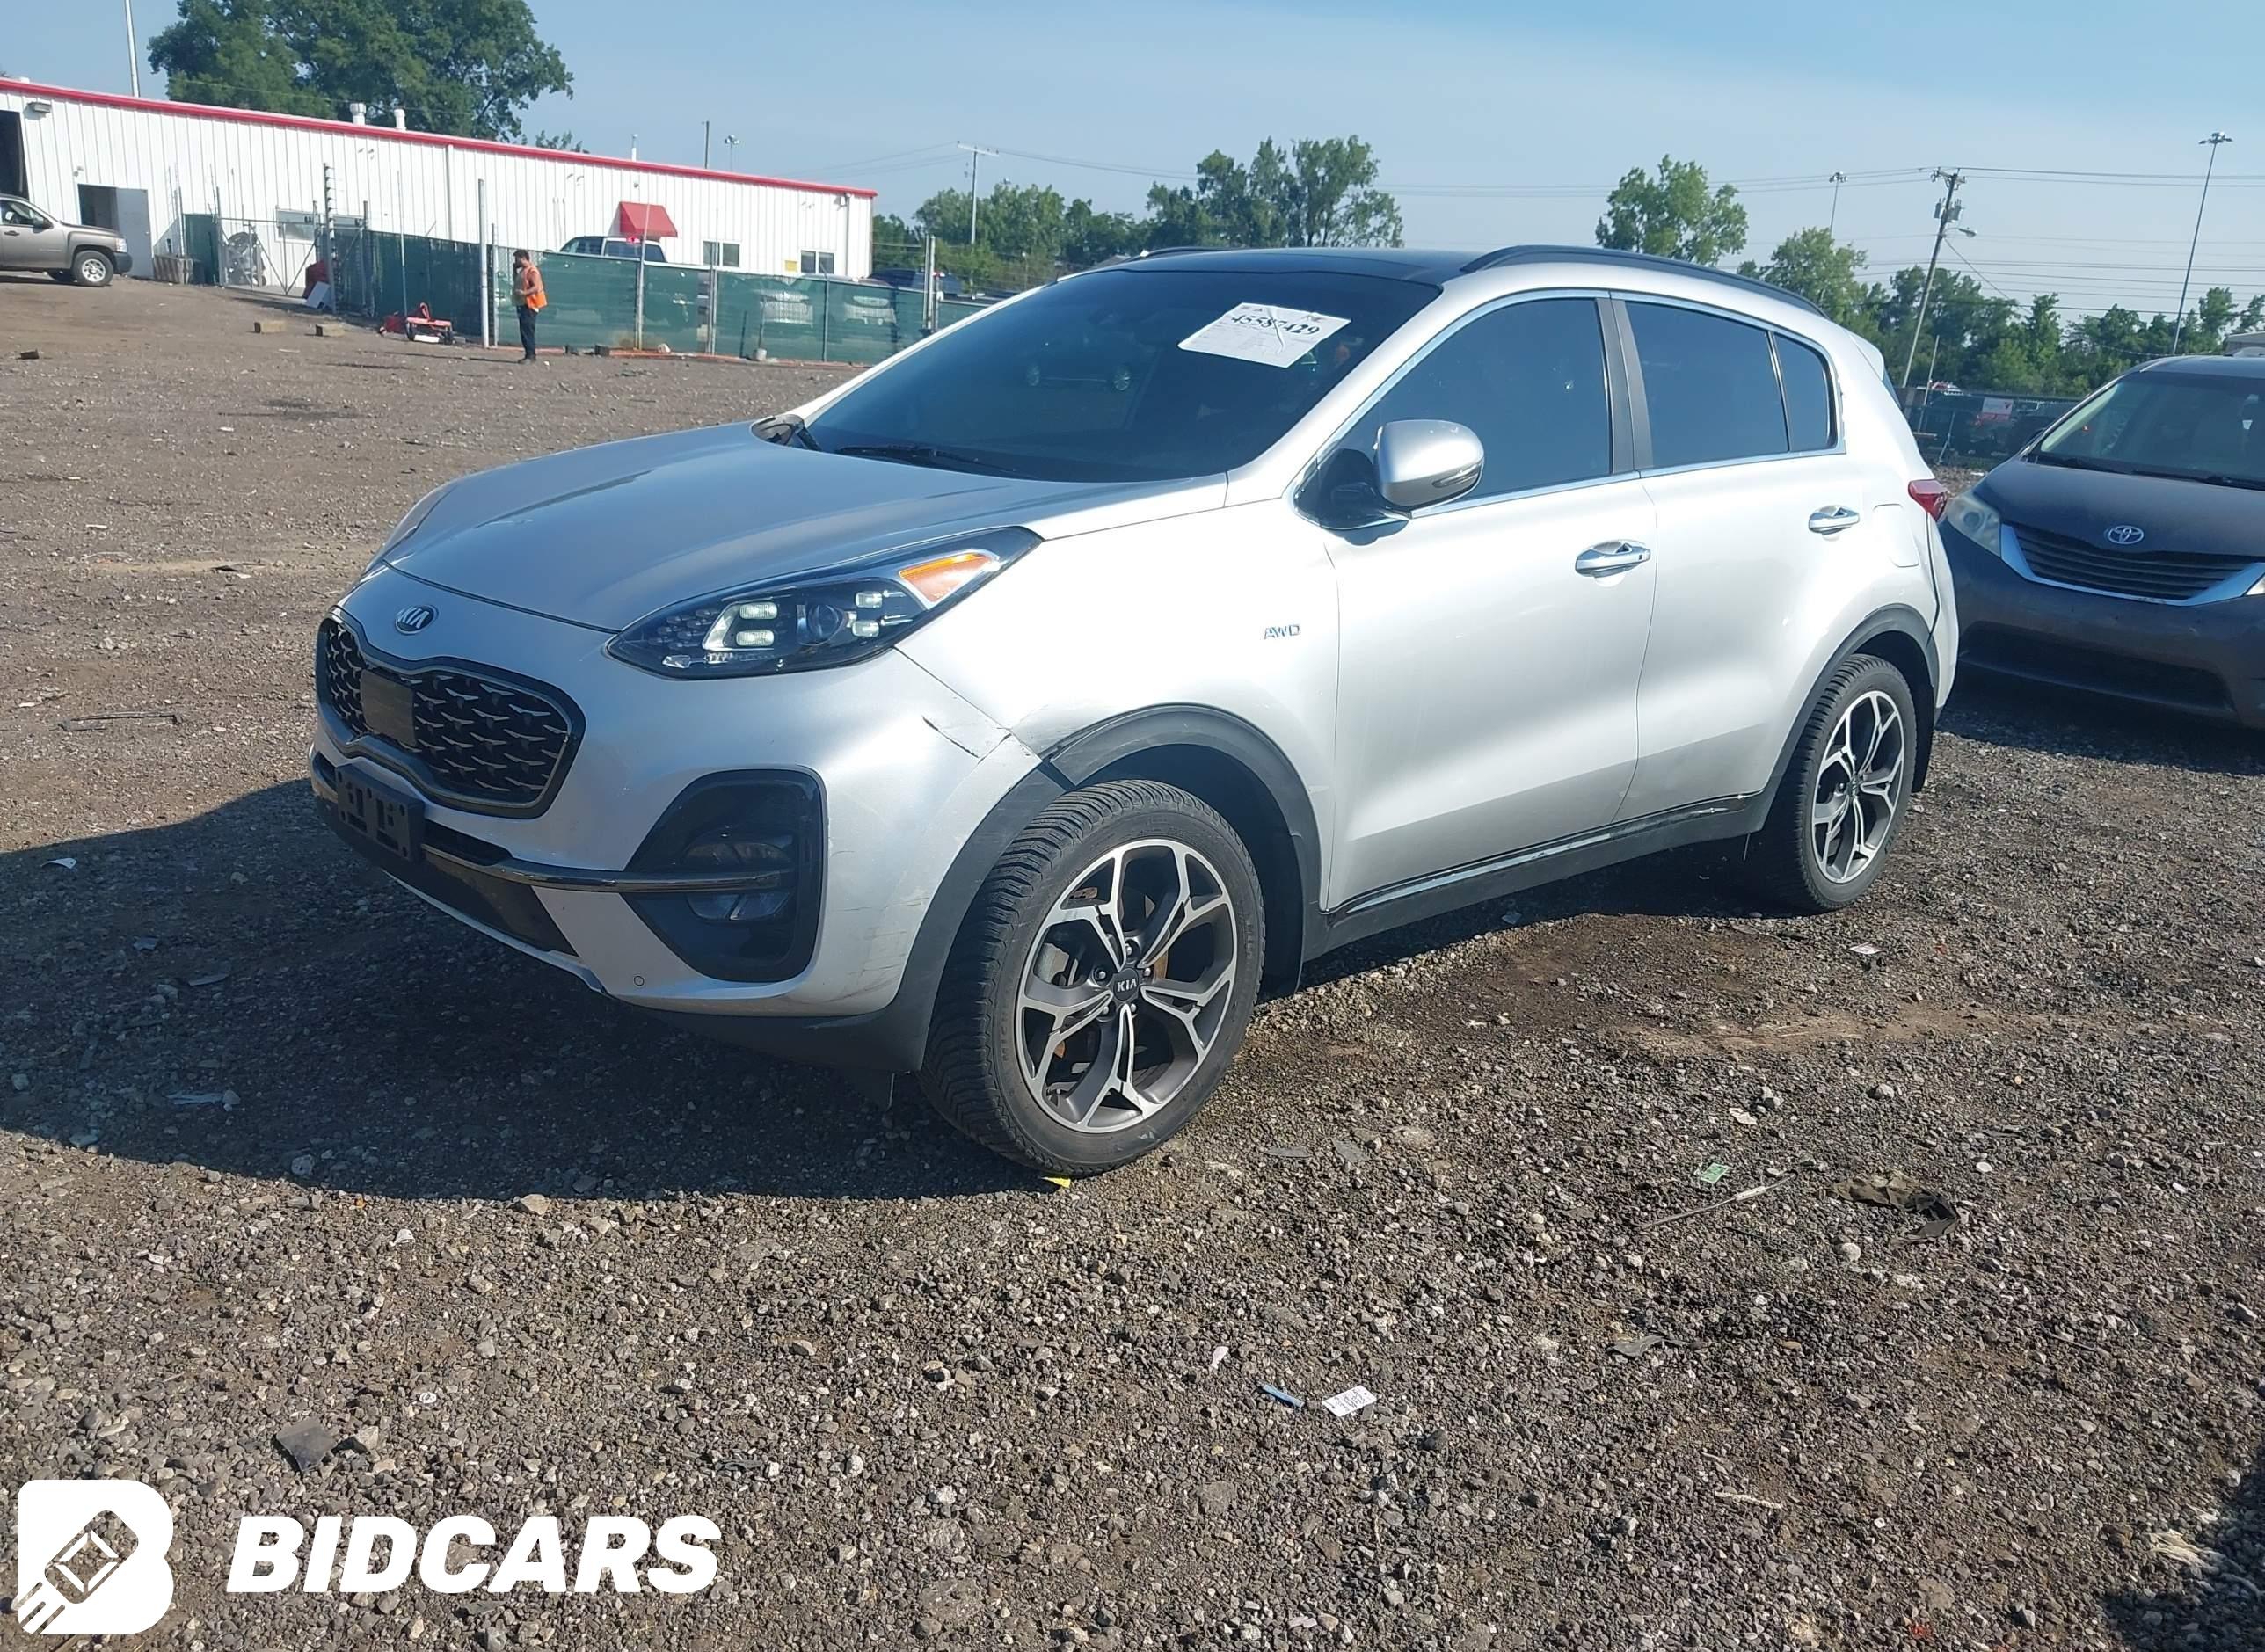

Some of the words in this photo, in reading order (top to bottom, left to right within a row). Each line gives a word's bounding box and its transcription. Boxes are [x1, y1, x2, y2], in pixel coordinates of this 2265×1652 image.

[397, 607, 430, 629] KIA
[1264, 624, 1300, 640] AWD
[1117, 978, 1137, 993] KIA
